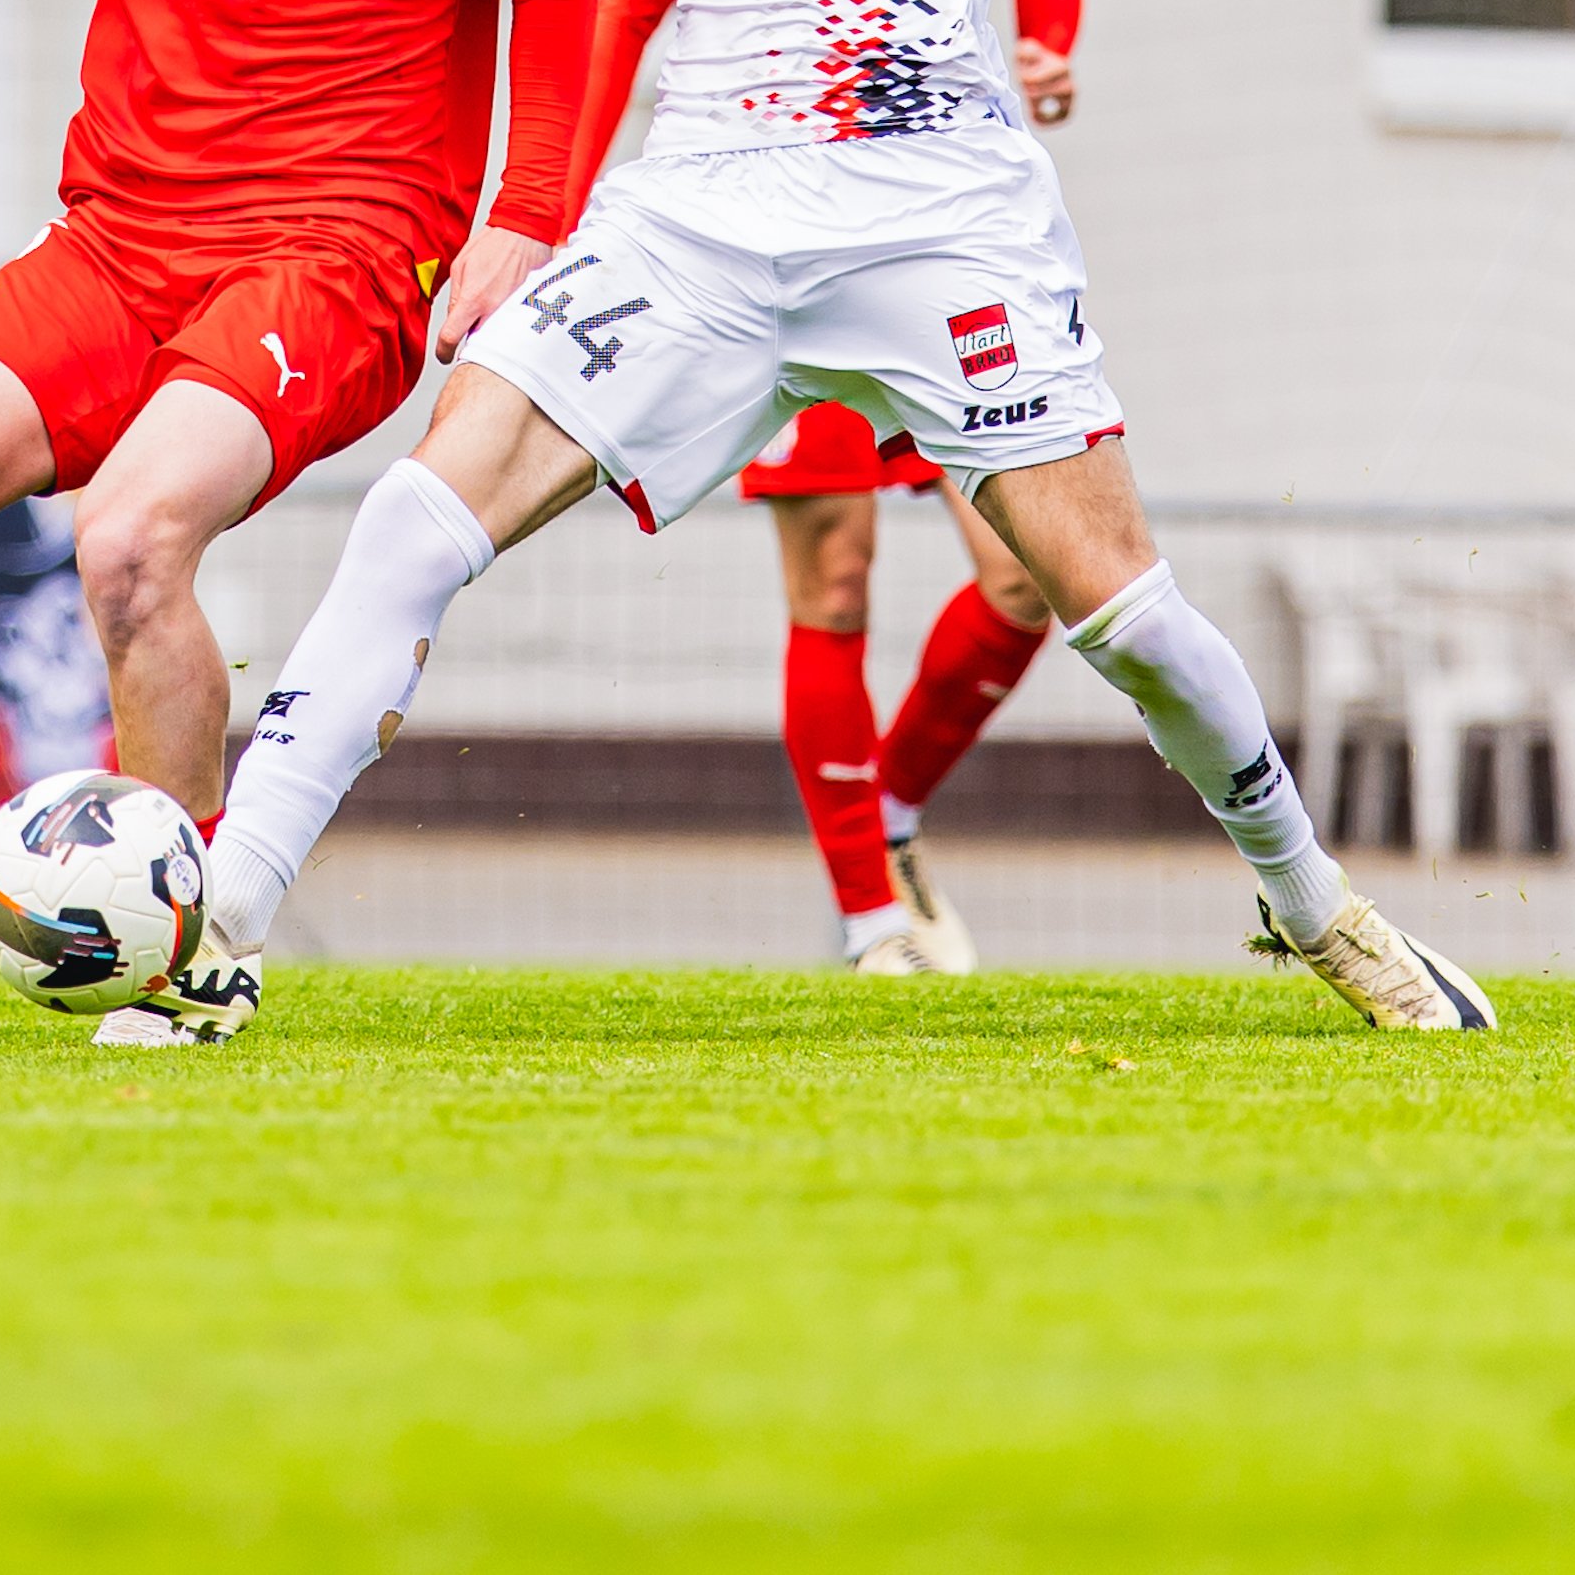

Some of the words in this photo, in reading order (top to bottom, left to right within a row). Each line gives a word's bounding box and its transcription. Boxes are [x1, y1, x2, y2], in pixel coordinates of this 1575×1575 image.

[520, 254, 654, 382] 44
[959, 322, 1006, 355] Start
[963, 346, 1011, 374] BRNO
[961, 395, 1049, 432] Zeus
